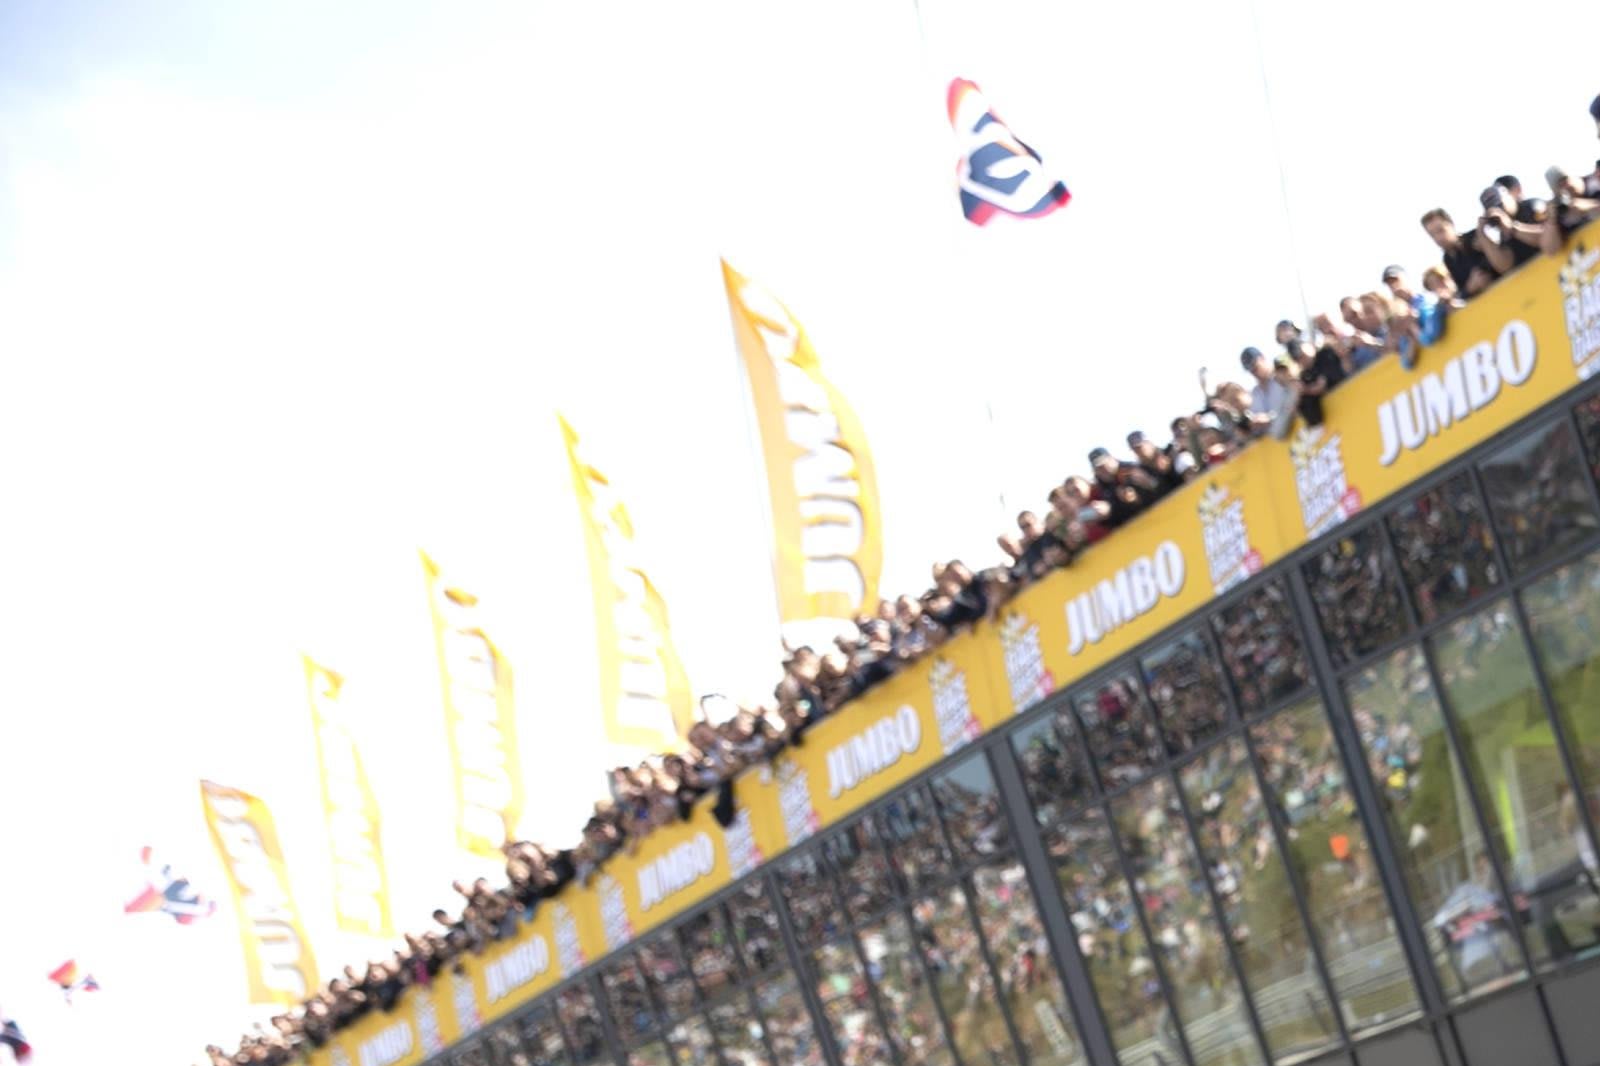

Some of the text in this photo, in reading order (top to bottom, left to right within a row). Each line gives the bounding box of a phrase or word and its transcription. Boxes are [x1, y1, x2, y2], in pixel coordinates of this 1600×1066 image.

[1377, 319, 1537, 467] JUMBO
[1064, 540, 1185, 656] JUMBO
[826, 704, 921, 798] JUMBO
